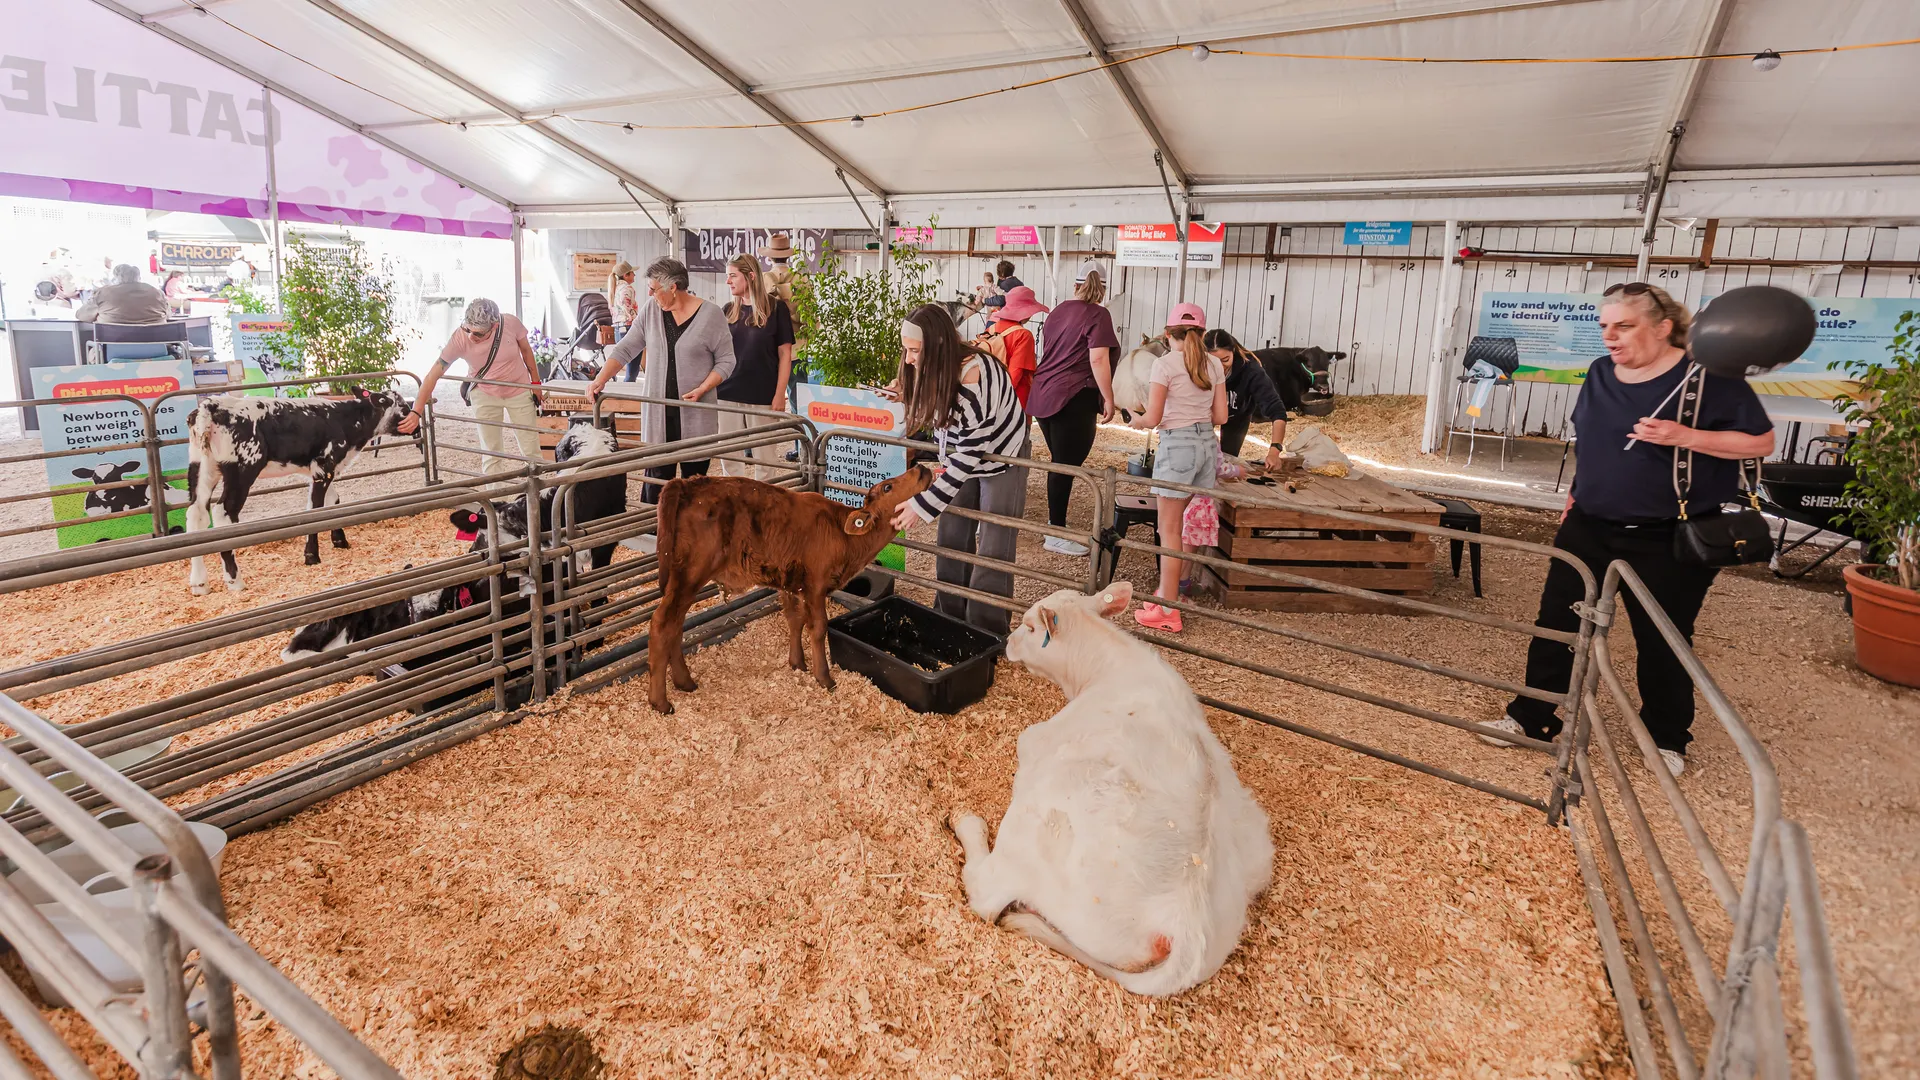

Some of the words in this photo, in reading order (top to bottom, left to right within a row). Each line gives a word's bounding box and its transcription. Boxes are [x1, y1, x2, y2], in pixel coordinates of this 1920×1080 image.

[1124, 230, 1141, 238] Black
[1142, 230, 1152, 239] Dog
[1154, 230, 1166, 238] Ride
[700, 228, 741, 260] Black
[1266, 262, 1278, 270] 23
[1400, 262, 1415, 271] 22
[1505, 268, 1516, 278] 21
[1659, 269, 1678, 278] 20
[1492, 300, 1518, 309] How
[1521, 302, 1544, 310] and
[1548, 302, 1575, 312] why
[1578, 302, 1596, 310] do
[1512, 311, 1560, 322] identify
[1820, 308, 1840, 316] do
[1815, 320, 1856, 329] ttle?
[60, 388, 88, 398] Did
[124, 382, 173, 395] know?
[63, 410, 128, 422] Newborn
[132, 406, 175, 416] cves
[812, 407, 829, 417] Did
[832, 412, 851, 421] you
[854, 412, 889, 425] know?
[65, 425, 91, 434] can
[96, 419, 136, 430] weigh
[67, 432, 128, 445] between
[156, 426, 178, 435] and
[835, 444, 856, 455] soft,
[857, 447, 881, 458] jelly-
[831, 454, 878, 469] coverings
[834, 476, 862, 486] shield
[846, 498, 864, 507] birt
